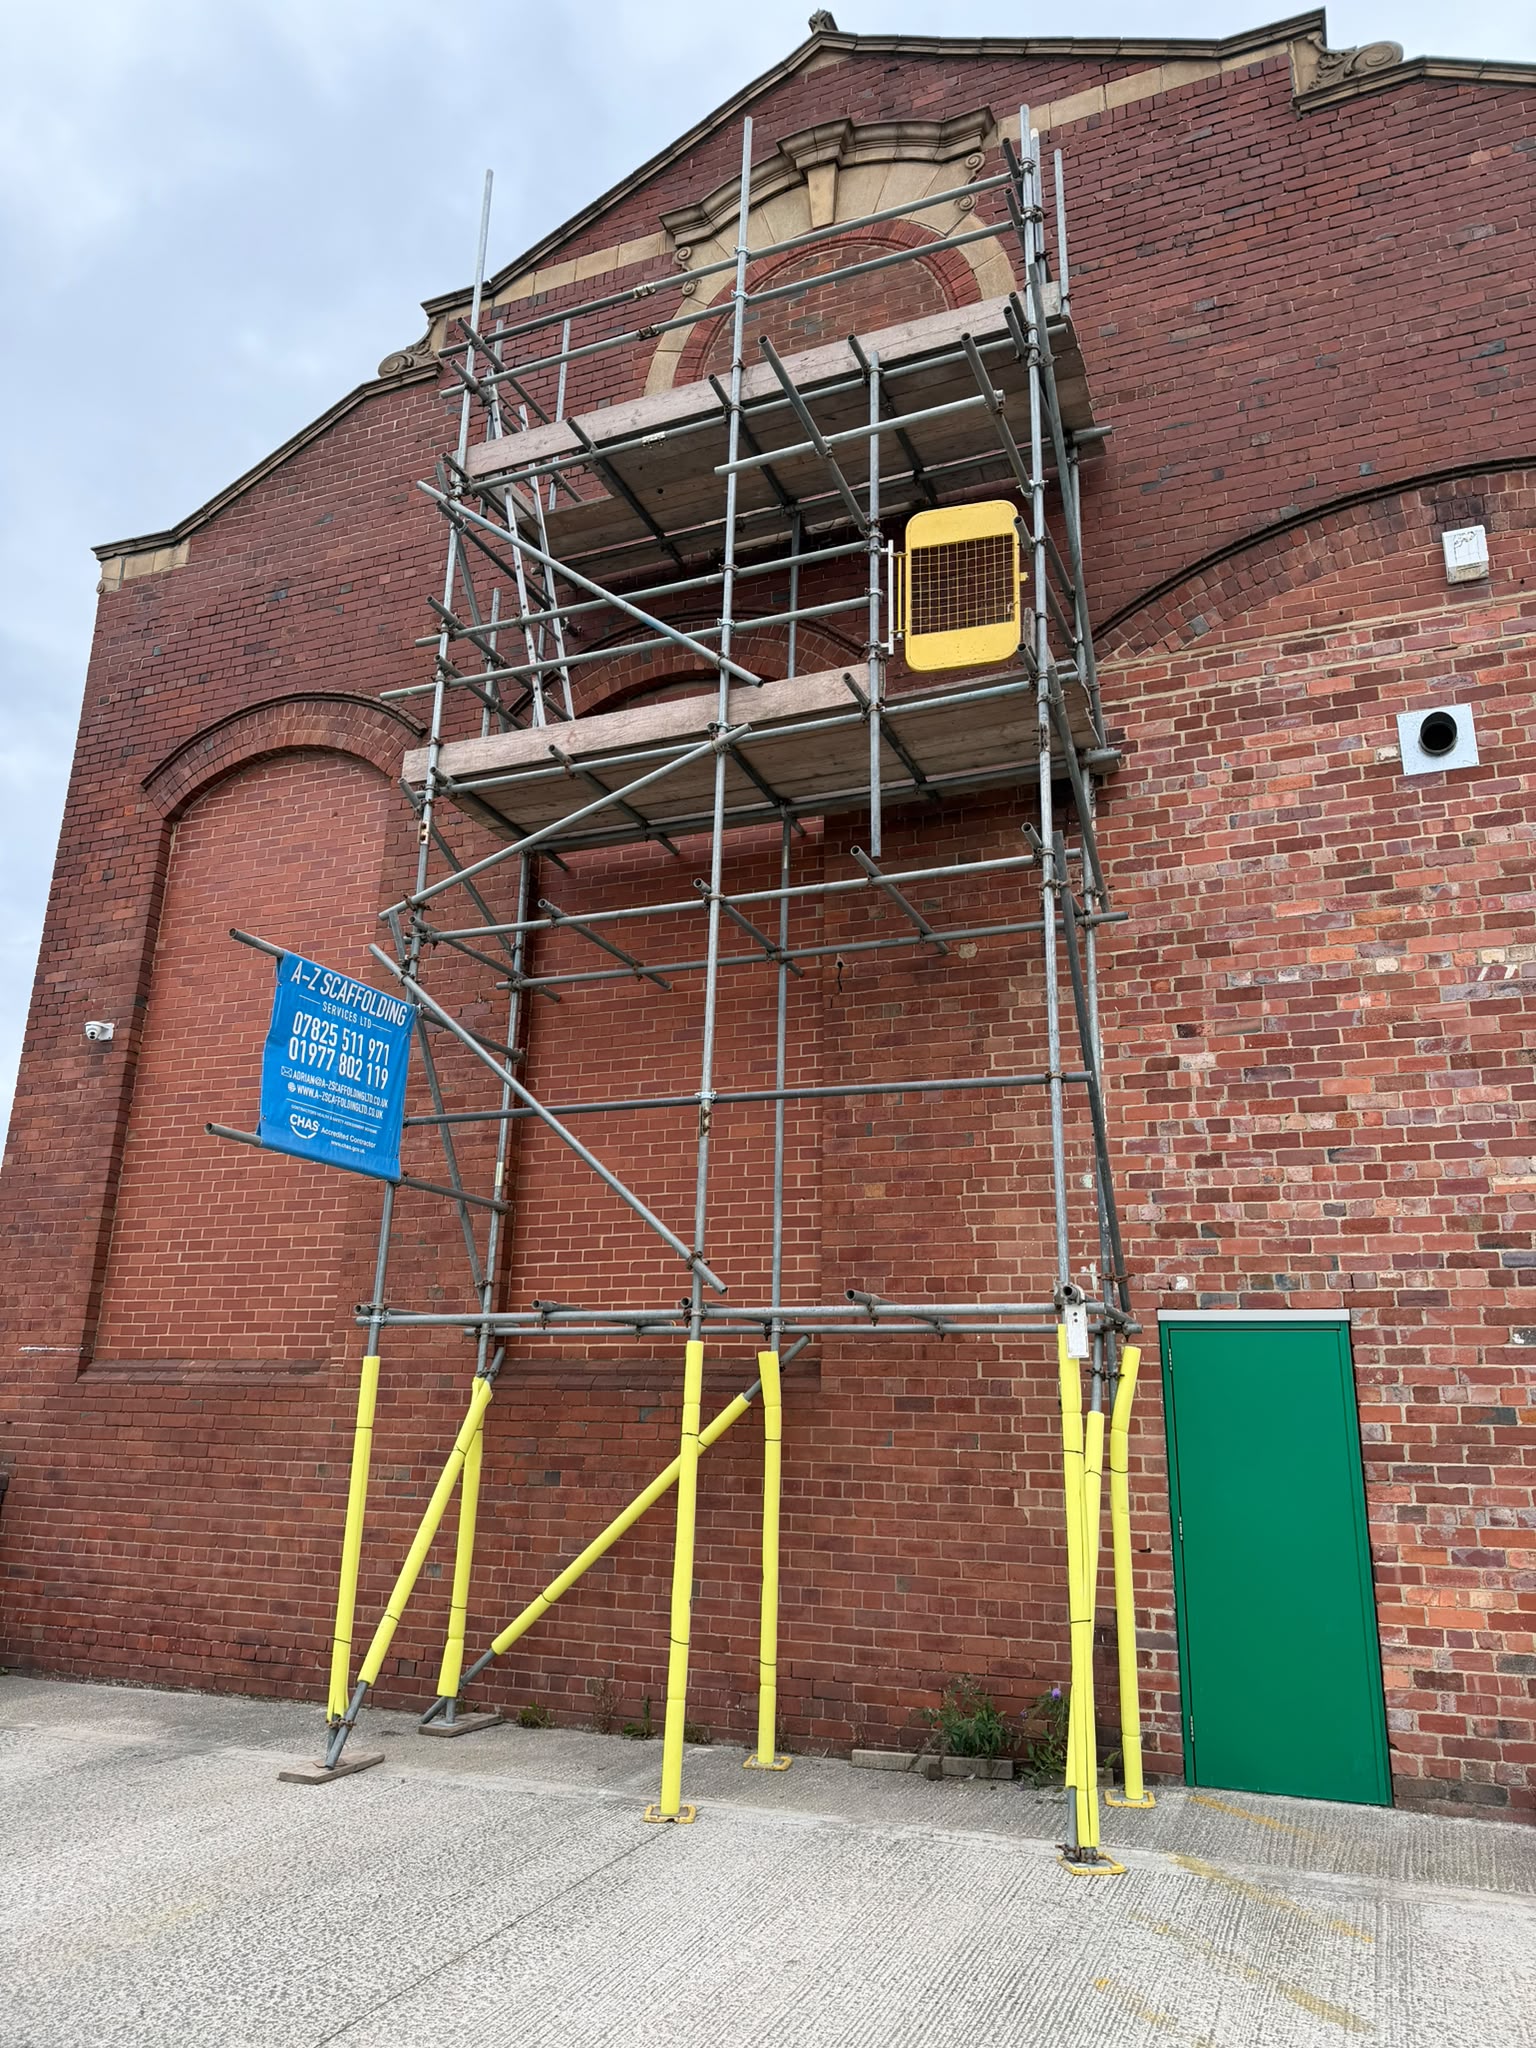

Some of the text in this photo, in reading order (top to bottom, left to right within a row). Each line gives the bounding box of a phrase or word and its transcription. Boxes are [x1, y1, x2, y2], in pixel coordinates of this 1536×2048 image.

[290, 961, 407, 1026] A-Z SCAFFOLDING
[322, 1002, 372, 1028] SERVICES LTD
[292, 1011, 390, 1066] 07825 511 971
[288, 1036, 389, 1090] 01977 802 119
[293, 1070, 388, 1108] ADRIAN@A-ZSCAFFOLDINGLTD.CO.UK
[296, 1084, 383, 1120] WWW.A-ZSCAFFOLDINGLTD.CO.UK
[289, 1113, 319, 1132] CHAS
[321, 1127, 377, 1149] Accredited Contractor
